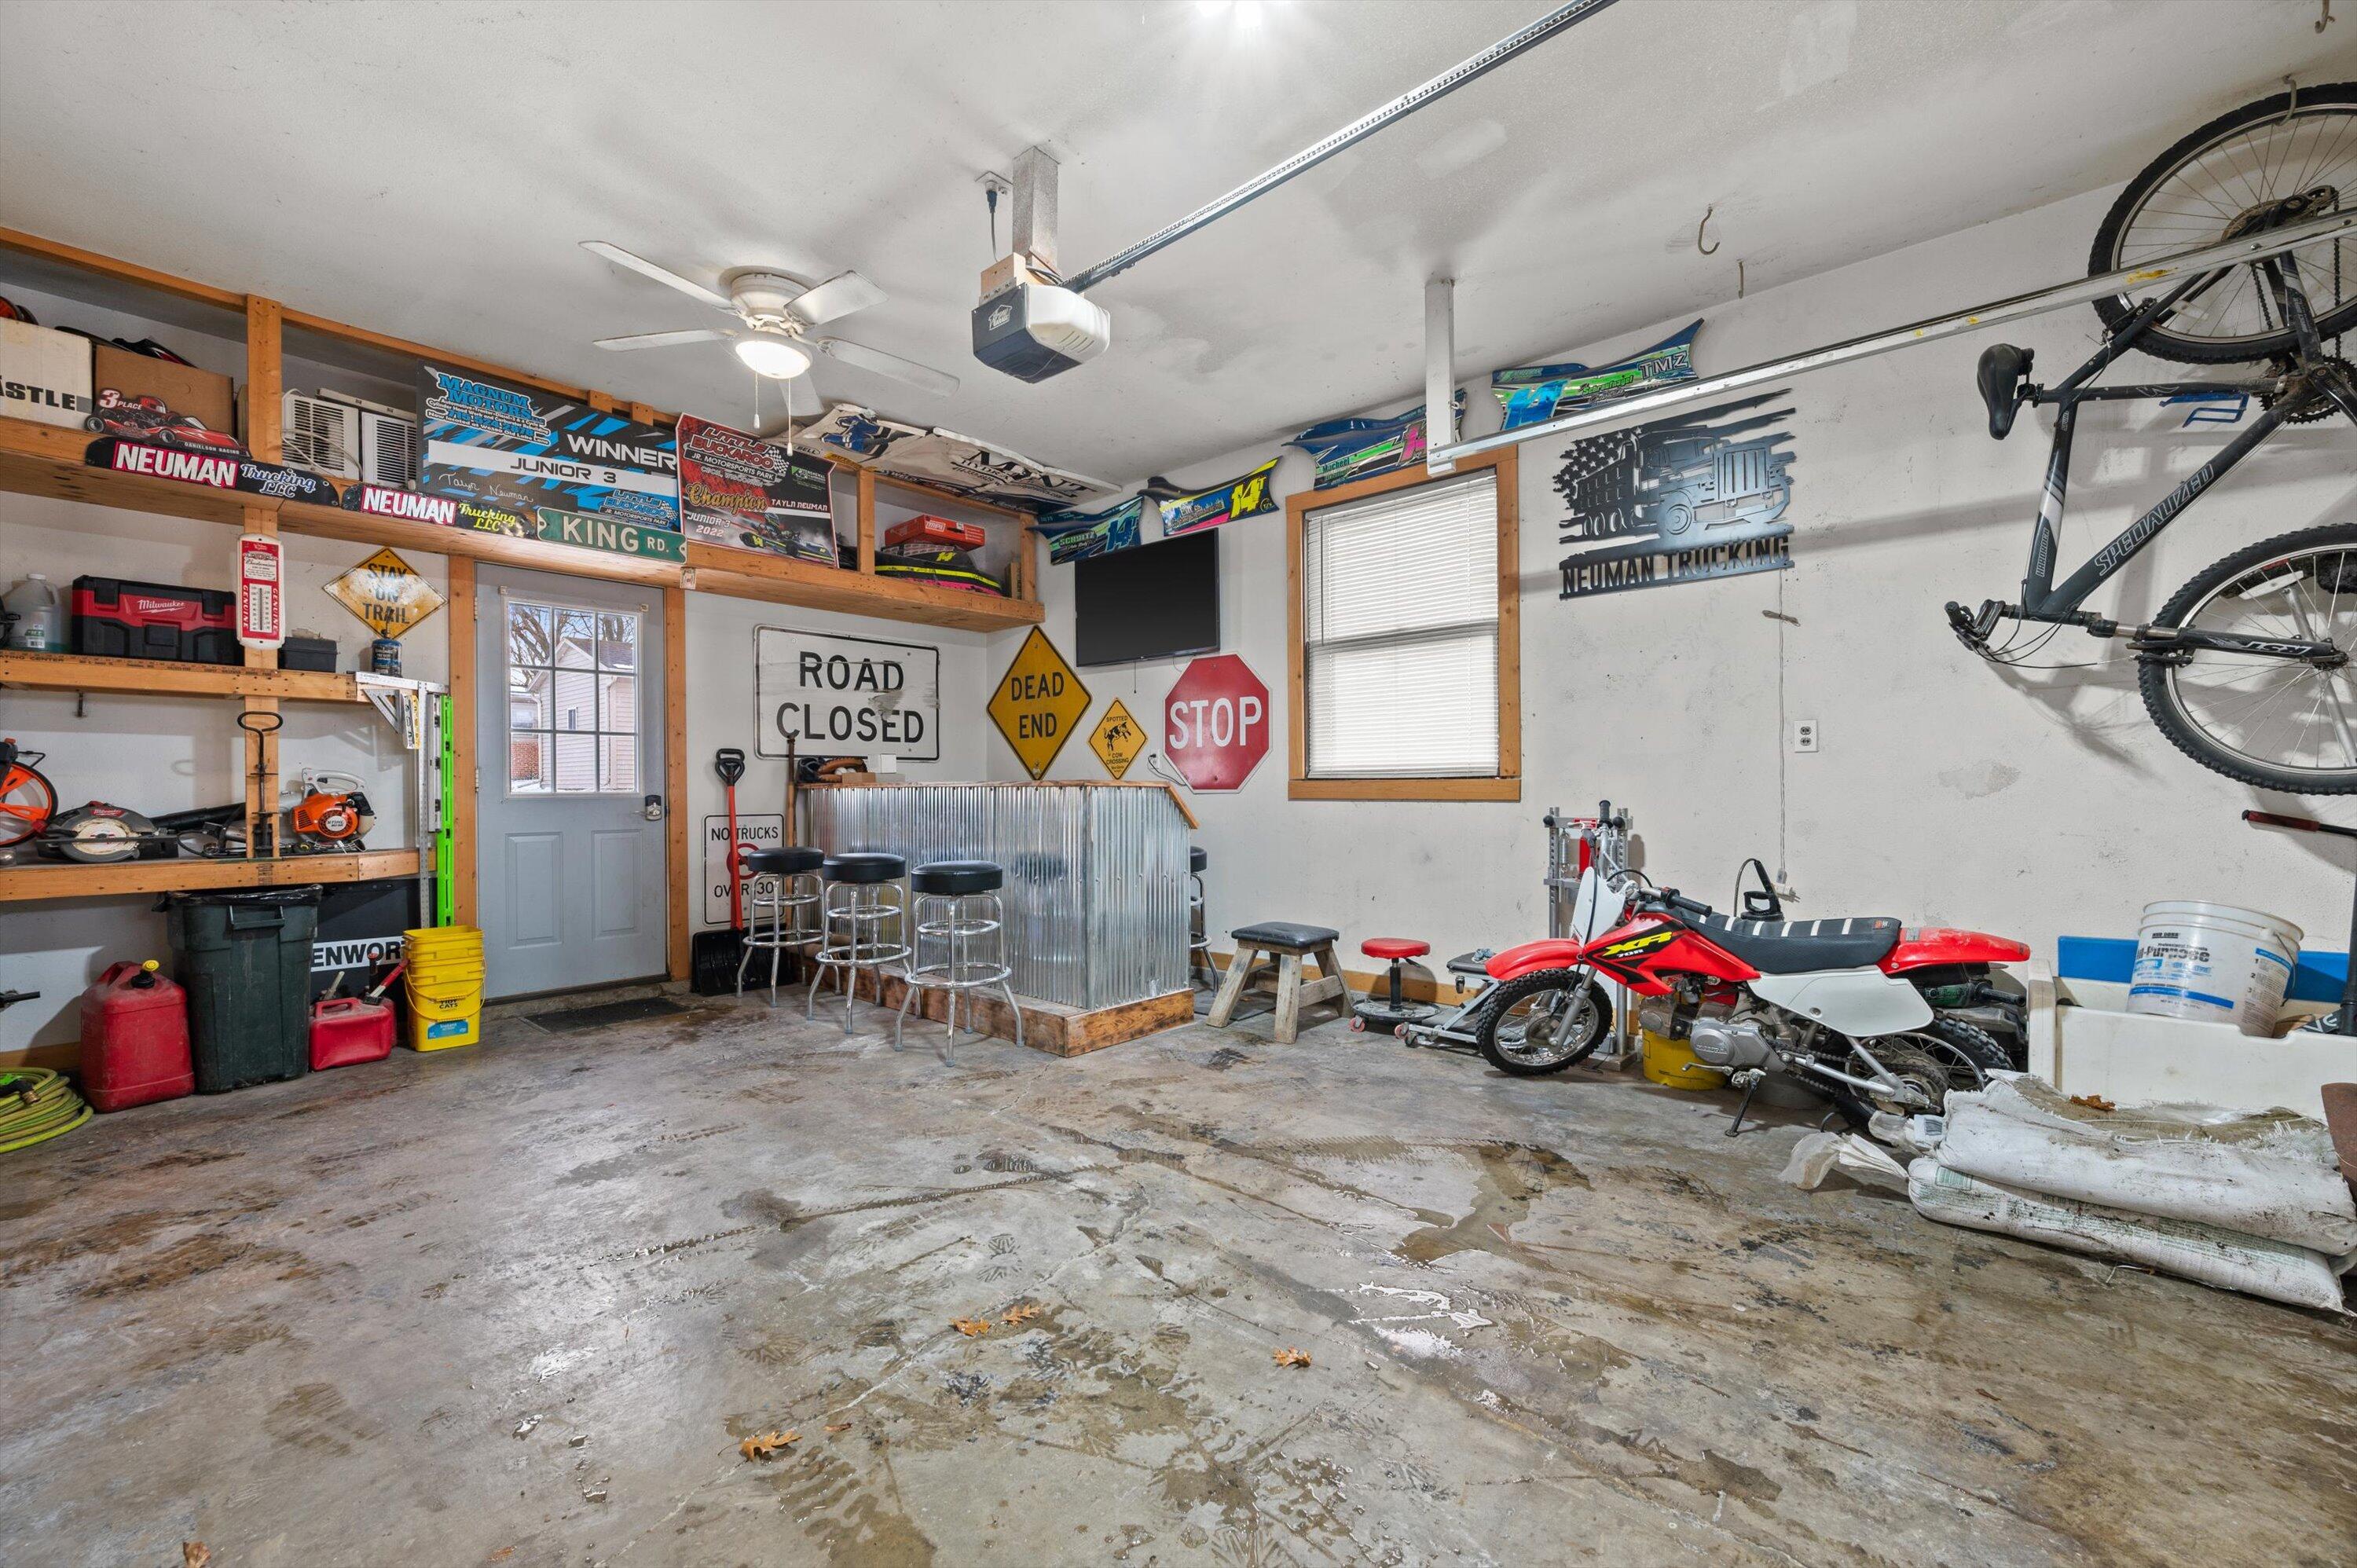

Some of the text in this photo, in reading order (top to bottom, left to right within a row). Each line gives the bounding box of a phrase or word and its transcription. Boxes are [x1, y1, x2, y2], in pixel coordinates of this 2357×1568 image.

[1638, 351, 1689, 379] TMZ
[99, 390, 143, 411] 3 PLACE
[438, 373, 529, 407] MAGNUM
[448, 389, 533, 420] MOTORS
[185, 441, 217, 452] DANIELSON
[566, 434, 678, 471] WINNER
[691, 434, 775, 469] BUCKAROO
[702, 427, 770, 455] LITTLE
[798, 445, 818, 454] BELL
[115, 443, 236, 487] NEUMAN
[240, 463, 316, 493] Trucking
[511, 457, 617, 483] JUNIOR 3
[704, 456, 755, 475] MOTORSPORTS
[756, 470, 773, 481] PARK
[259, 481, 297, 498] LLC
[686, 482, 768, 517] Champion
[363, 488, 456, 525] NEUMAN
[458, 502, 516, 526] Trucking
[604, 496, 668, 518] BUCKAROO
[687, 511, 731, 528] JUNIOR 3
[2095, 463, 2214, 576] SPECIALIZED
[474, 518, 500, 532] LLC
[563, 516, 640, 552] KING
[695, 525, 724, 537] 2022
[368, 563, 408, 579] STAY
[1563, 537, 1790, 594] NEUMAN TRUCKING
[137, 599, 185, 610] Milwaukee
[363, 603, 410, 625] TRAIL
[800, 650, 904, 693] ROAD
[1011, 672, 1065, 702] DEAD
[776, 702, 924, 743] CLOSED
[1019, 713, 1057, 739] END
[1169, 696, 1262, 749] STOP
[712, 826, 779, 841] NO TRUCKS
[714, 881, 774, 898] OVR 30
[1603, 931, 1673, 957] XR
[1616, 949, 1644, 958] 70R
